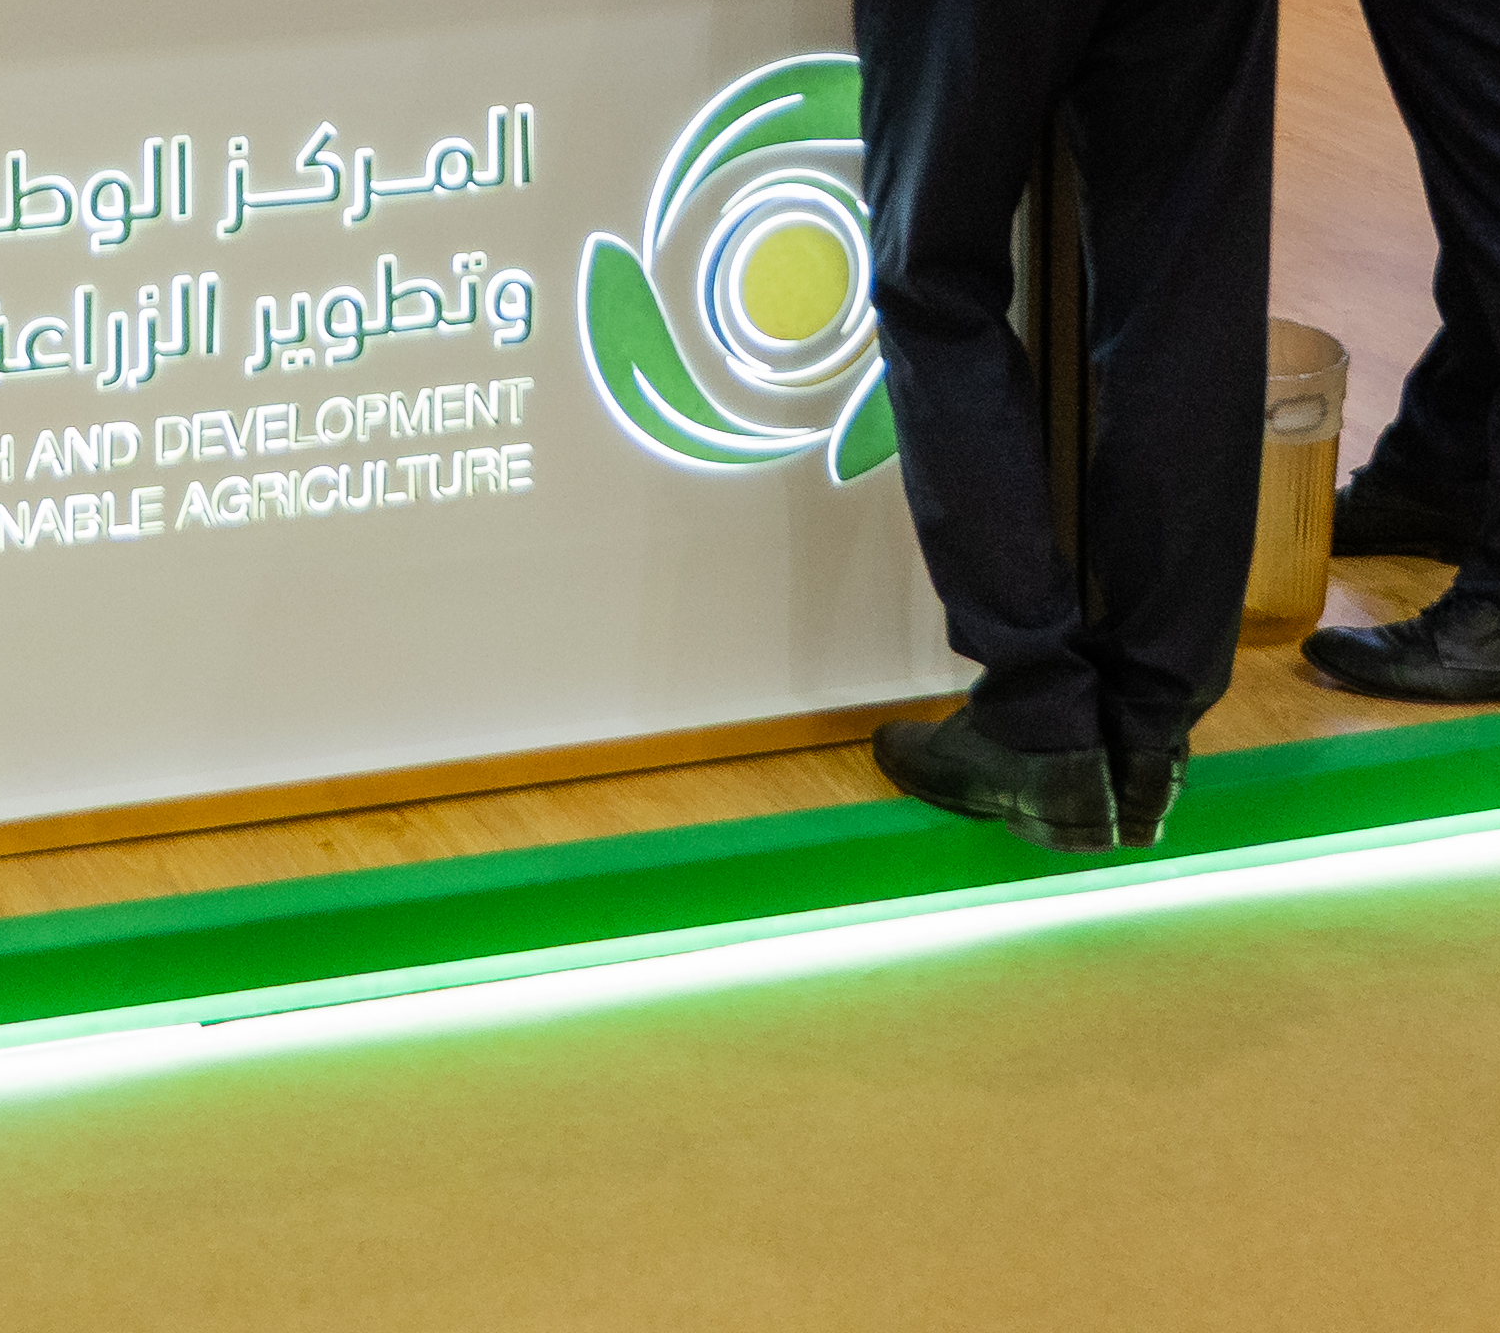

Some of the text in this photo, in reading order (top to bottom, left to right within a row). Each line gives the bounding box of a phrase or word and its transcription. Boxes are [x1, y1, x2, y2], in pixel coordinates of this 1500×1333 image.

[217, 102, 533, 238] المركز
[244, 250, 534, 379] وتطوير
[25, 421, 142, 480] AND
[154, 377, 534, 466] DEVELOPMENT
[174, 442, 533, 530] AGRICULTURE
